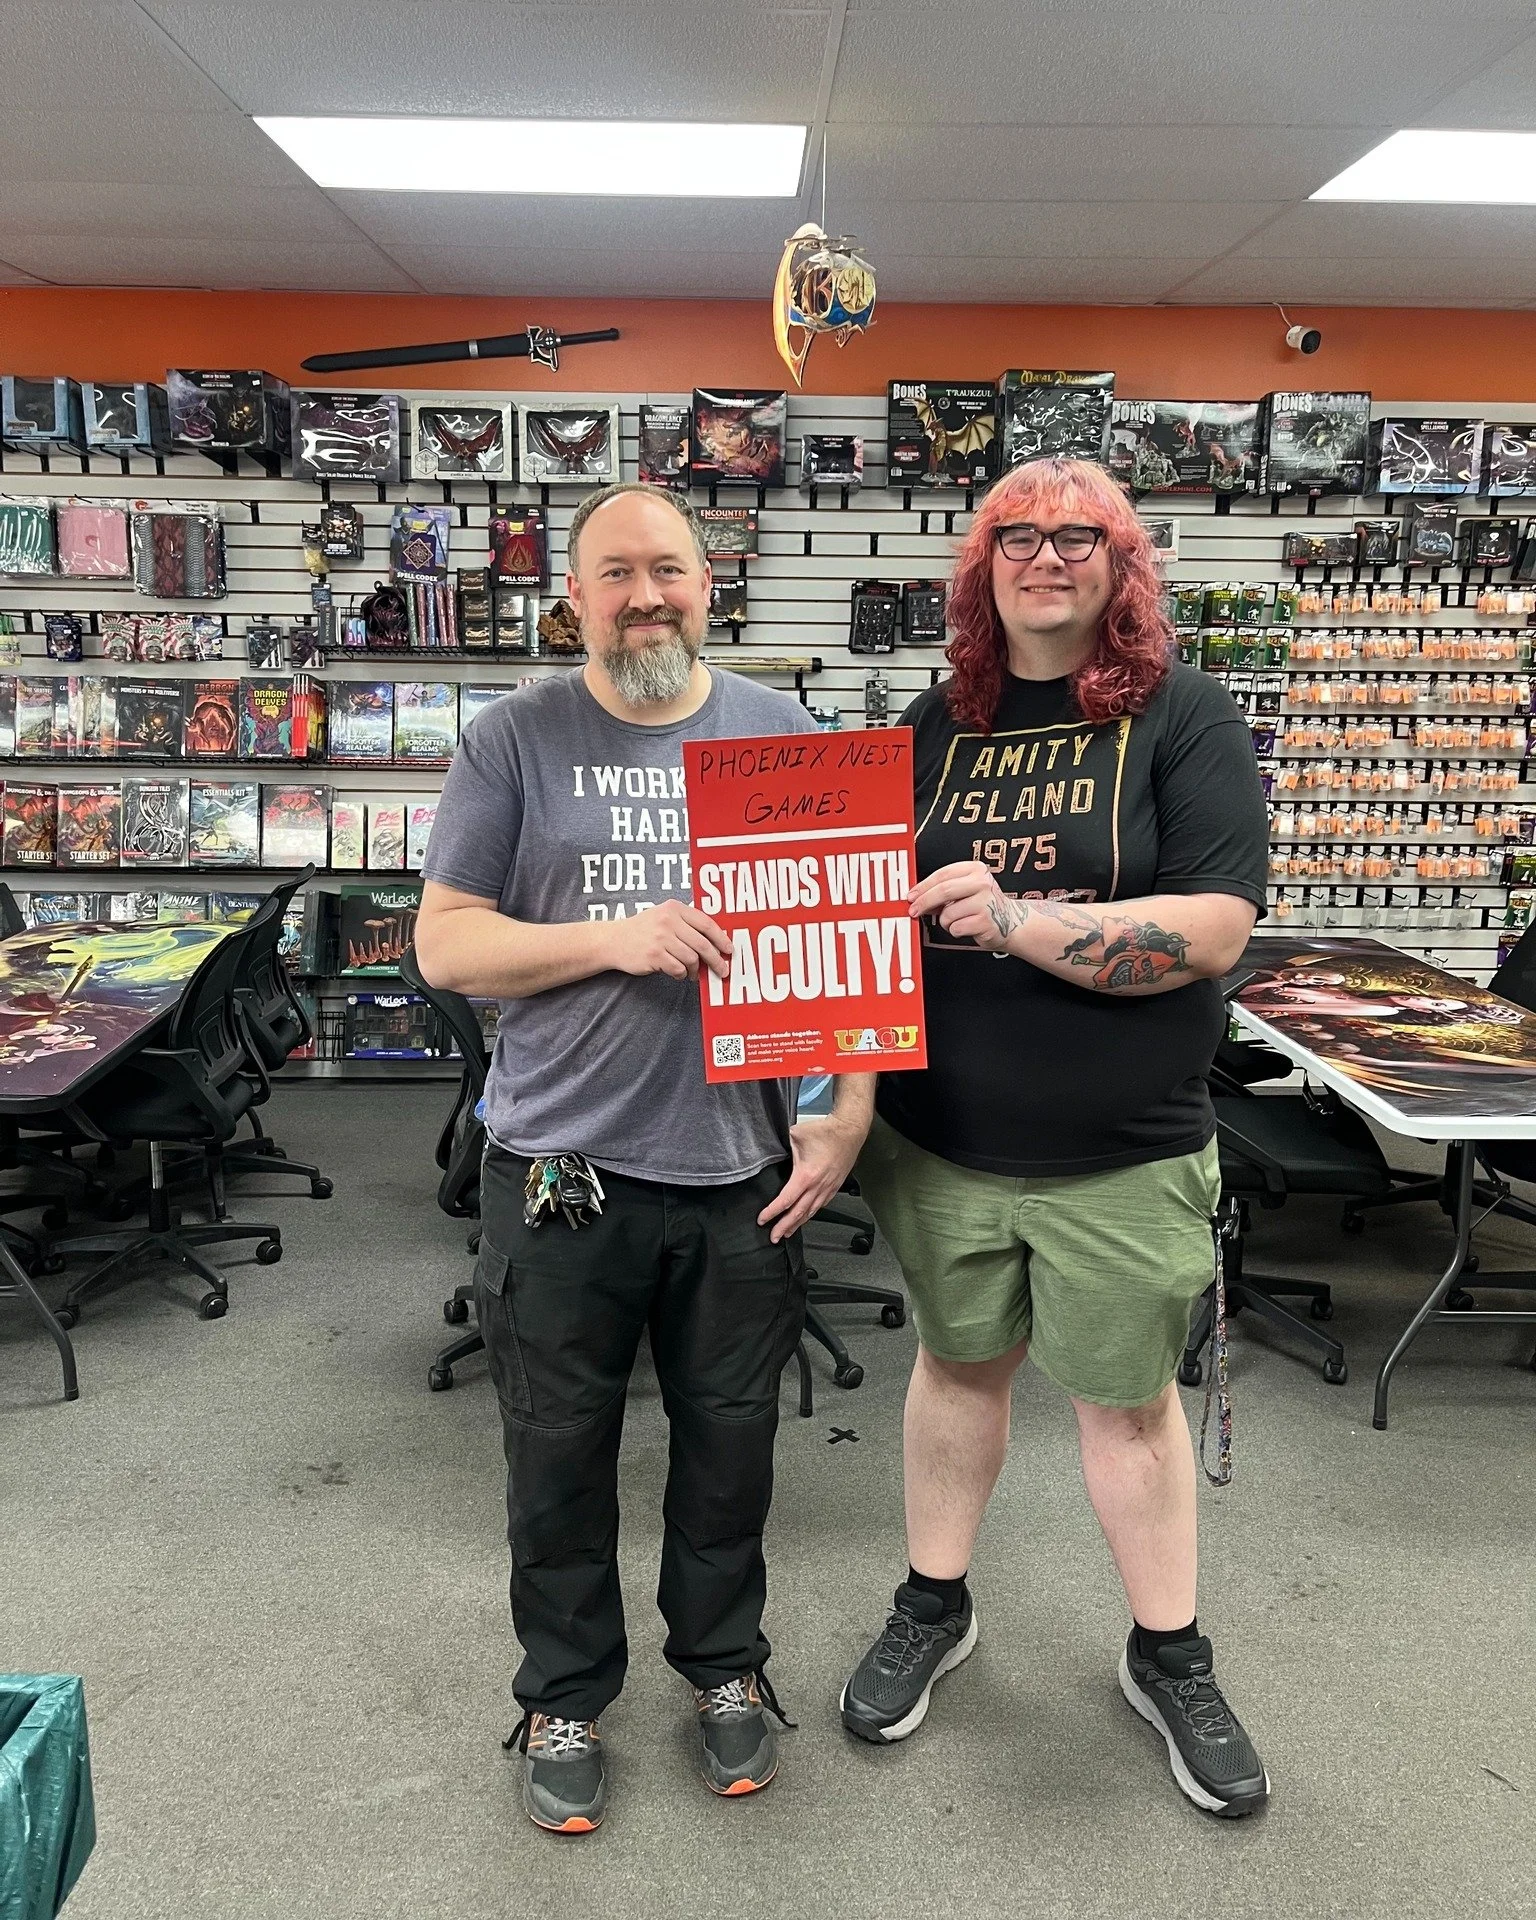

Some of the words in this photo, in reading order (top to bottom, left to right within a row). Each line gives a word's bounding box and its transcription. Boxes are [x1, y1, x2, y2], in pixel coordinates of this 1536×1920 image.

[893, 383, 927, 400] BONES
[1273, 393, 1312, 413] BONES
[644, 414, 682, 423] DRAGONLANCE
[1111, 401, 1156, 425] BONES
[700, 509, 748, 519] ENCOUNTER
[397, 572, 417, 580] SPELL
[417, 573, 438, 582] CODEX
[194, 683, 235, 692] EBERRON
[1257, 681, 1280, 692] BONES
[253, 690, 288, 698] DRAGON
[255, 698, 287, 706] DELVES
[345, 744, 374, 752] REALMS
[404, 739, 446, 747] FORGOTTEN
[969, 732, 1094, 778] AMITY
[700, 745, 829, 785] PHOENIX
[838, 740, 908, 770] NEST
[573, 766, 585, 797] I
[591, 765, 687, 799] WORK
[36, 788, 44, 797] &
[89, 788, 97, 797] &
[203, 788, 235, 797] ESSENTIALS
[235, 788, 246, 796] KIT
[744, 789, 850, 824] GAMES
[942, 778, 1096, 824] ISLAND
[17, 850, 45, 860] STARTER
[45, 851, 57, 861] SET
[70, 850, 98, 860] STARTER
[98, 850, 111, 860] SET
[971, 832, 1057, 875] 1975
[581, 853, 648, 893] FOR
[699, 856, 821, 916] STANDS
[824, 850, 911, 906] WITH
[168, 895, 202, 906] ANIME
[371, 892, 418, 904] WarLock
[374, 995, 409, 1005] WarLock
[792, 1029, 822, 1038] together.
